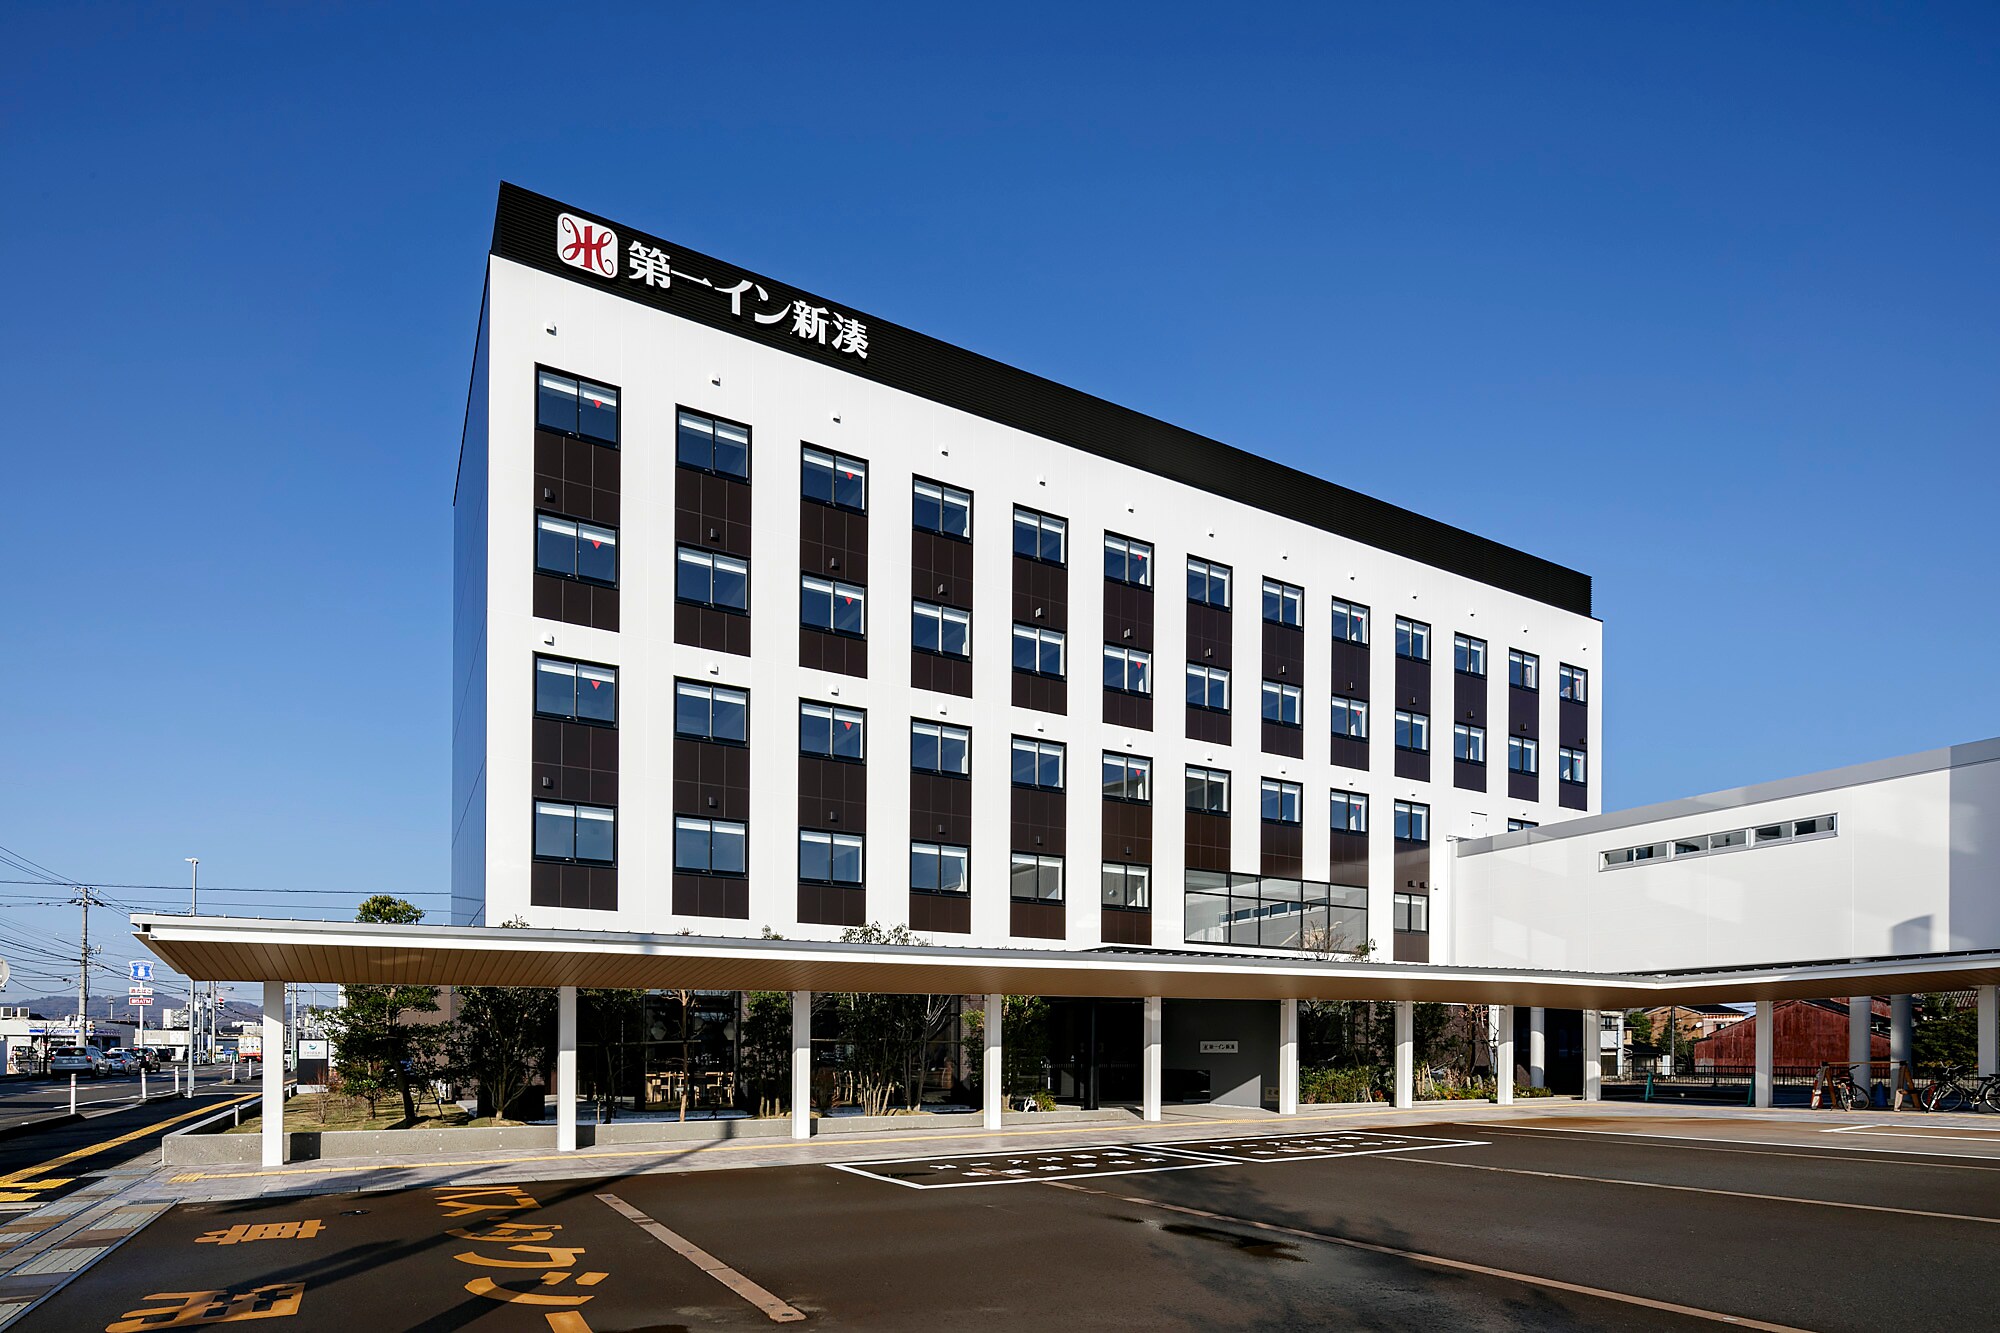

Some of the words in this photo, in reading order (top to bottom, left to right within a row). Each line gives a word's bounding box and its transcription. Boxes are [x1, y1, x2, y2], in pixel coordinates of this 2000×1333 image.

[628, 240, 869, 359] 第一イン新湊
